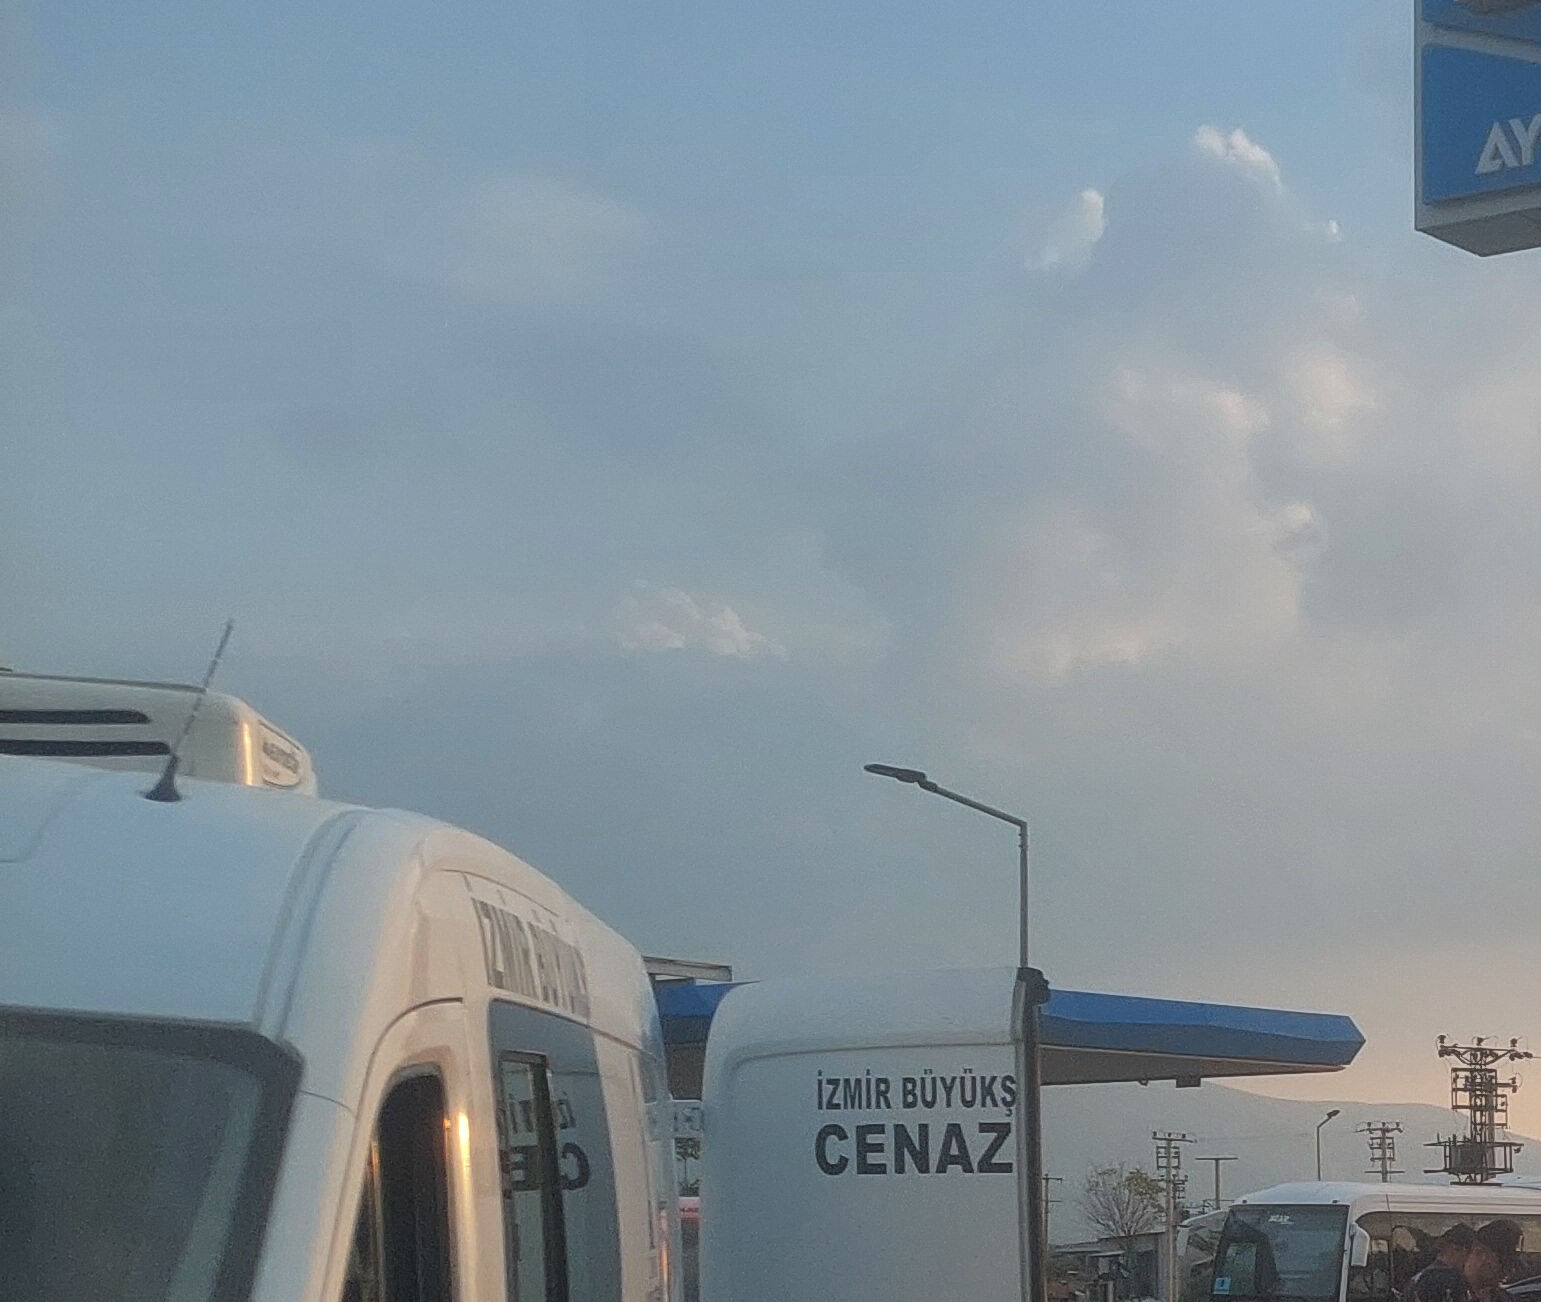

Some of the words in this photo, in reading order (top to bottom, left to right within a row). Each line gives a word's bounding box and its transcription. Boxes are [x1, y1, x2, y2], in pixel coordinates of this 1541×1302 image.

[816, 1068, 891, 1110] İZMİR
[902, 1068, 1017, 1116] BÜYÜKŞ
[815, 1121, 1014, 1176] CENAZ
